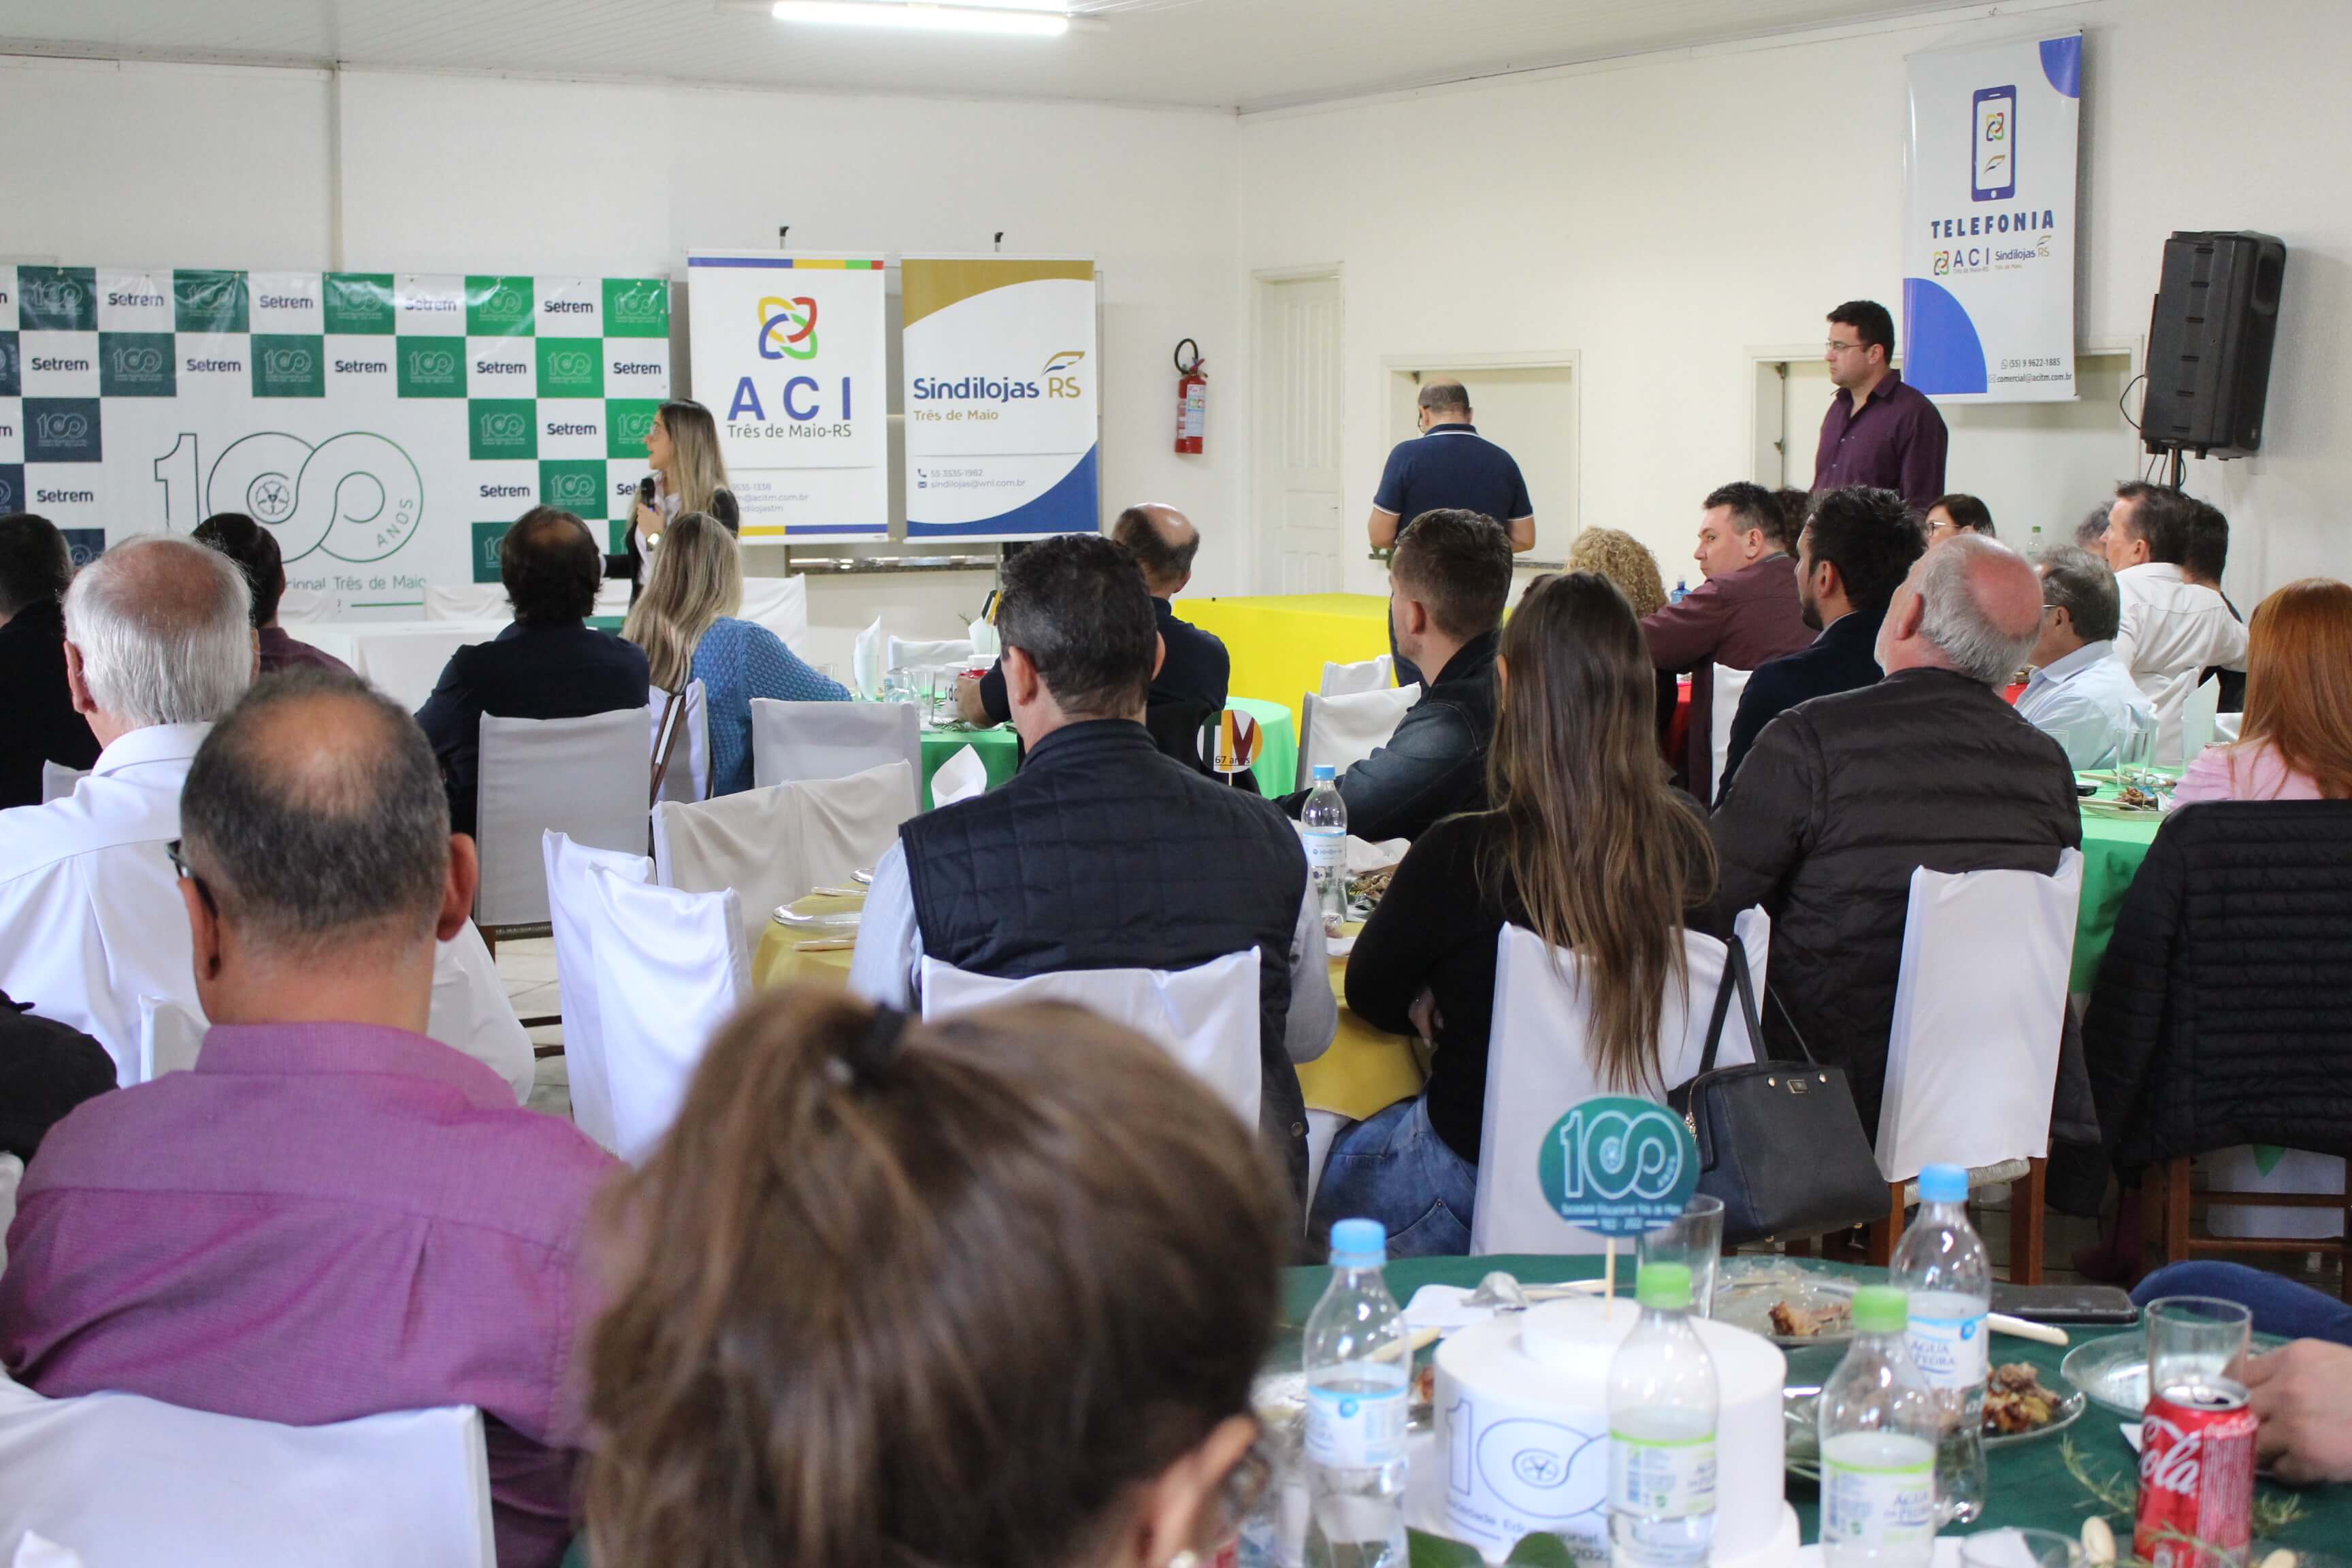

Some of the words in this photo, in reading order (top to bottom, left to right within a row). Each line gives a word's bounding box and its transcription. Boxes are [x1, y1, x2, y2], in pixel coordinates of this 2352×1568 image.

[1931, 210, 2054, 239] TELEFONIA
[1953, 247, 1990, 268] ACI
[1995, 248, 2036, 261] Sindilojas
[2038, 246, 2050, 258] RS
[108, 293, 164, 307] Setrem
[259, 295, 314, 309] Setrem
[544, 301, 593, 313] Setrem
[31, 357, 89, 371] Setrem
[186, 359, 241, 372] Setrem
[335, 360, 387, 373] Setrem
[476, 361, 527, 374] Setrem
[613, 362, 662, 374] Setrem
[913, 376, 1040, 403] Sindilojas
[1048, 376, 1081, 399] RS
[727, 376, 851, 421] ACI
[914, 410, 941, 421] Três
[946, 410, 963, 421] de
[967, 410, 999, 421] Maio
[546, 423, 597, 435] Setrem
[727, 424, 761, 438] Três
[765, 423, 783, 438] de
[789, 423, 852, 438] Maio-RS
[37, 489, 94, 502] Setrem
[480, 485, 530, 497] Setrem
[369, 575, 386, 590] de
[1215, 755, 1226, 764] 67
